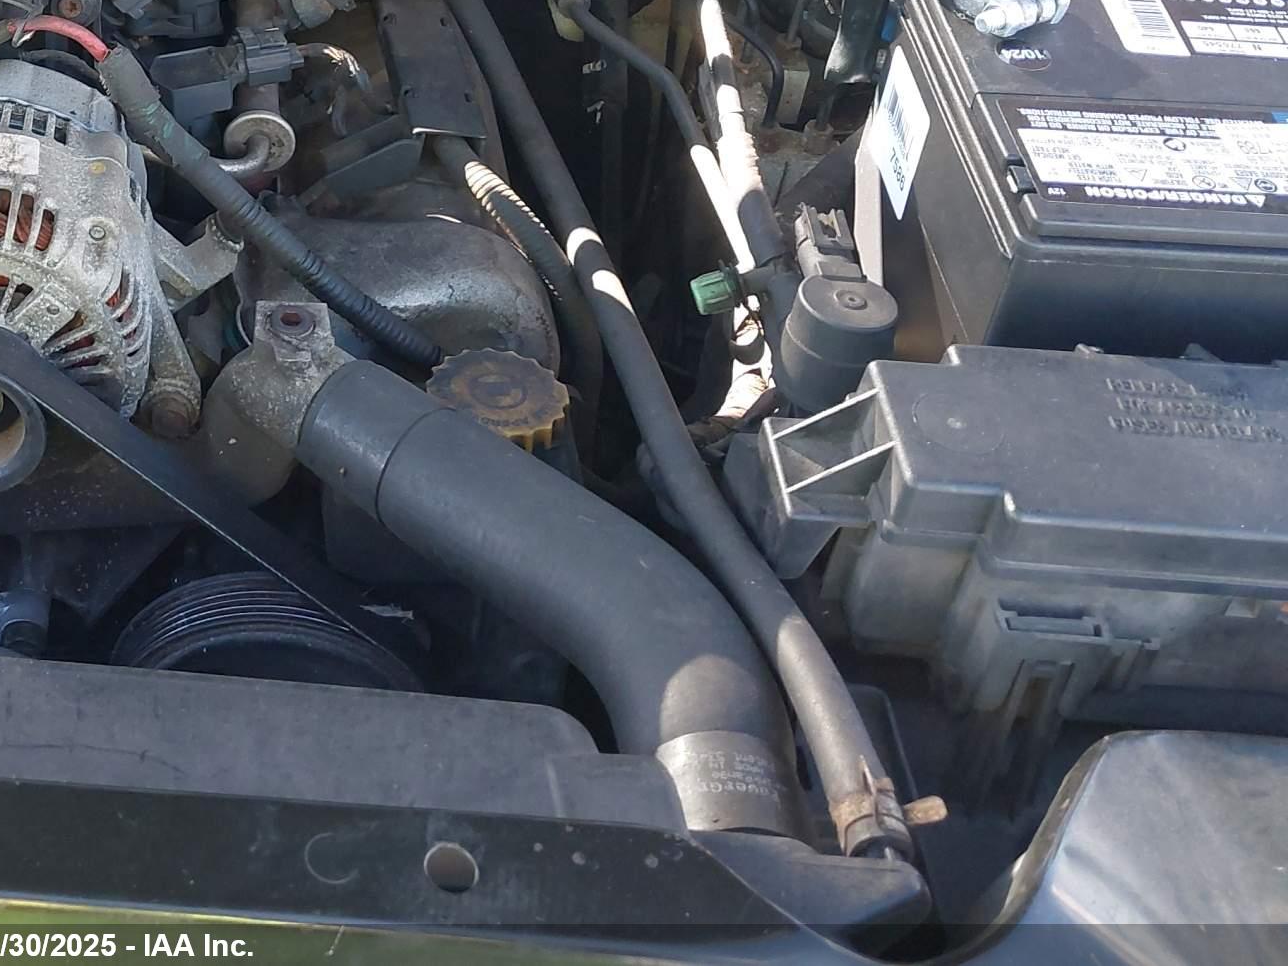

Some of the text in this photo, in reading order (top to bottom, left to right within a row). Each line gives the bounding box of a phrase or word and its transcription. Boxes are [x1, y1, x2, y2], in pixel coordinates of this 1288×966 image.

[1026, 114, 1046, 122] FOR
[1082, 111, 1127, 121] CHARGING
[1128, 113, 1162, 122] PROPER
[1164, 115, 1198, 124] FOLLOW
[1030, 120, 1049, 128] NOT
[1113, 119, 1133, 127] NOT
[1096, 124, 1112, 133] OR
[1111, 125, 1162, 134] EXPLOSION
[1047, 186, 1249, 205] DANGER/POISON 12V
